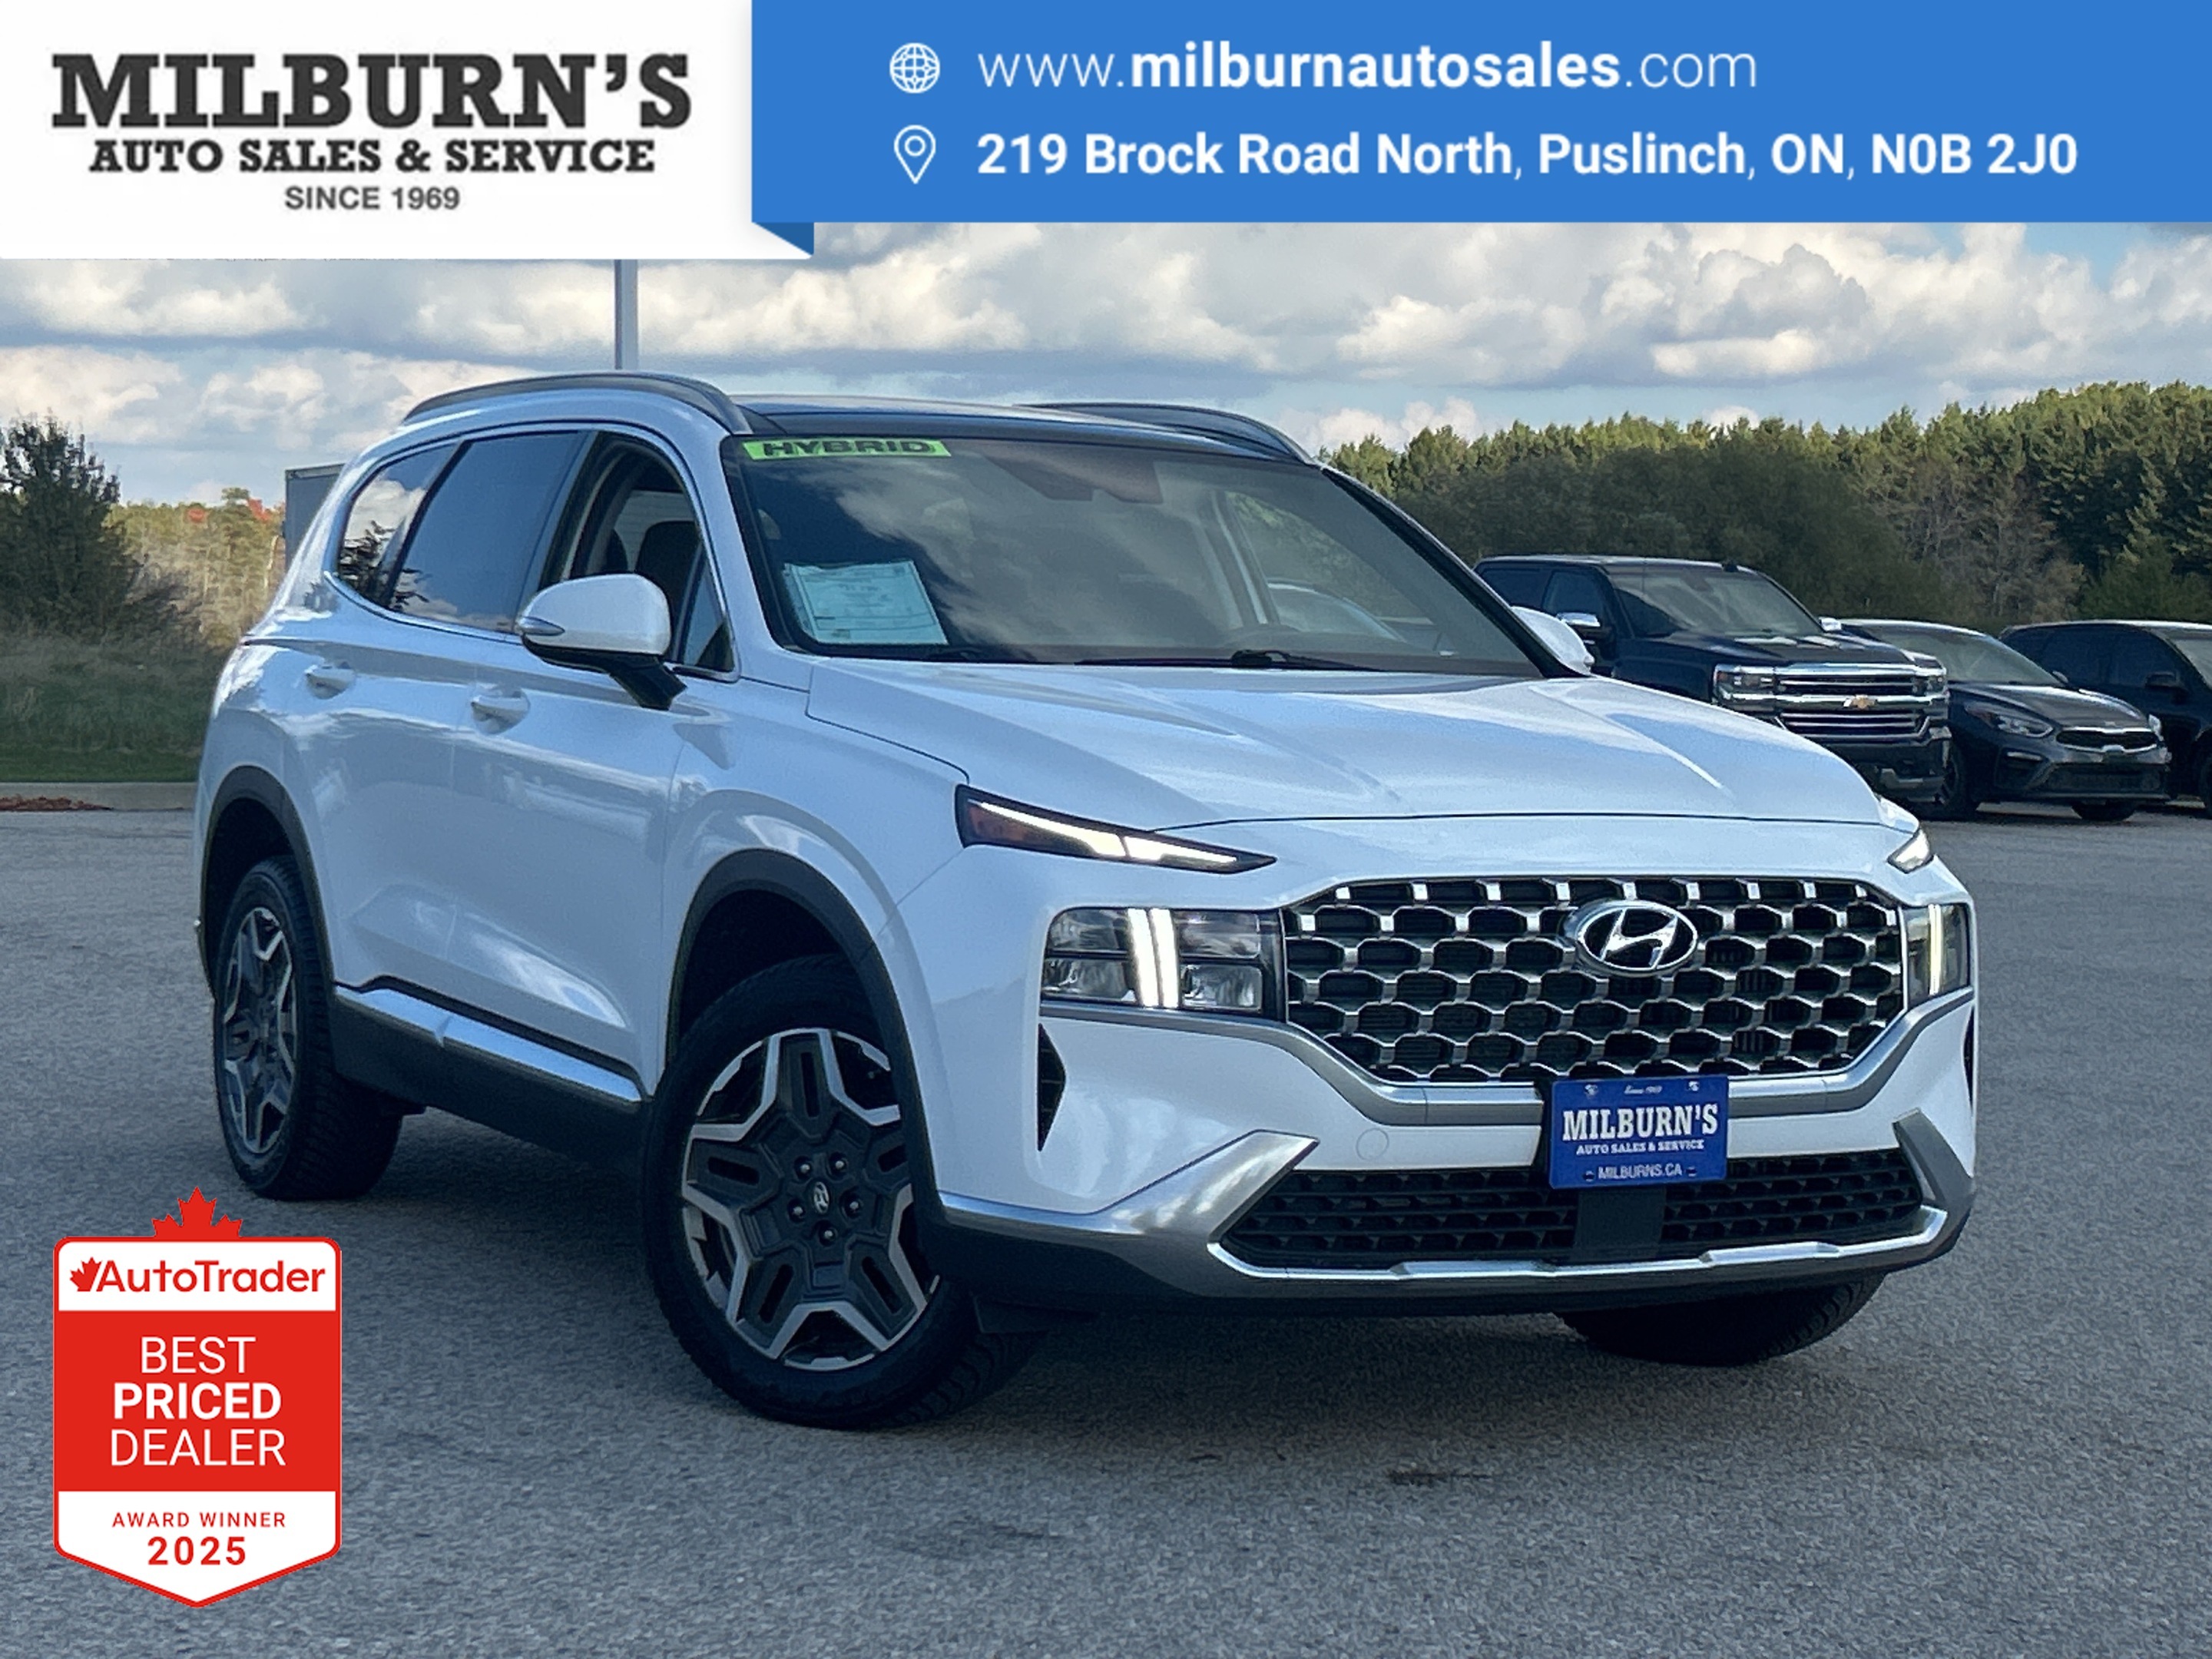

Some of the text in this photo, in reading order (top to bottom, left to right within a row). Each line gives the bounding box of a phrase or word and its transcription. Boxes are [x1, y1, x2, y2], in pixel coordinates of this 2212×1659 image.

[763, 440, 934, 456] HYBRID
[1562, 1103, 1719, 1141] MILBURN'S
[1576, 1139, 1705, 1155] AUTO SALES & SERVICE
[1598, 1163, 1683, 1180] MILBURNS.CA
